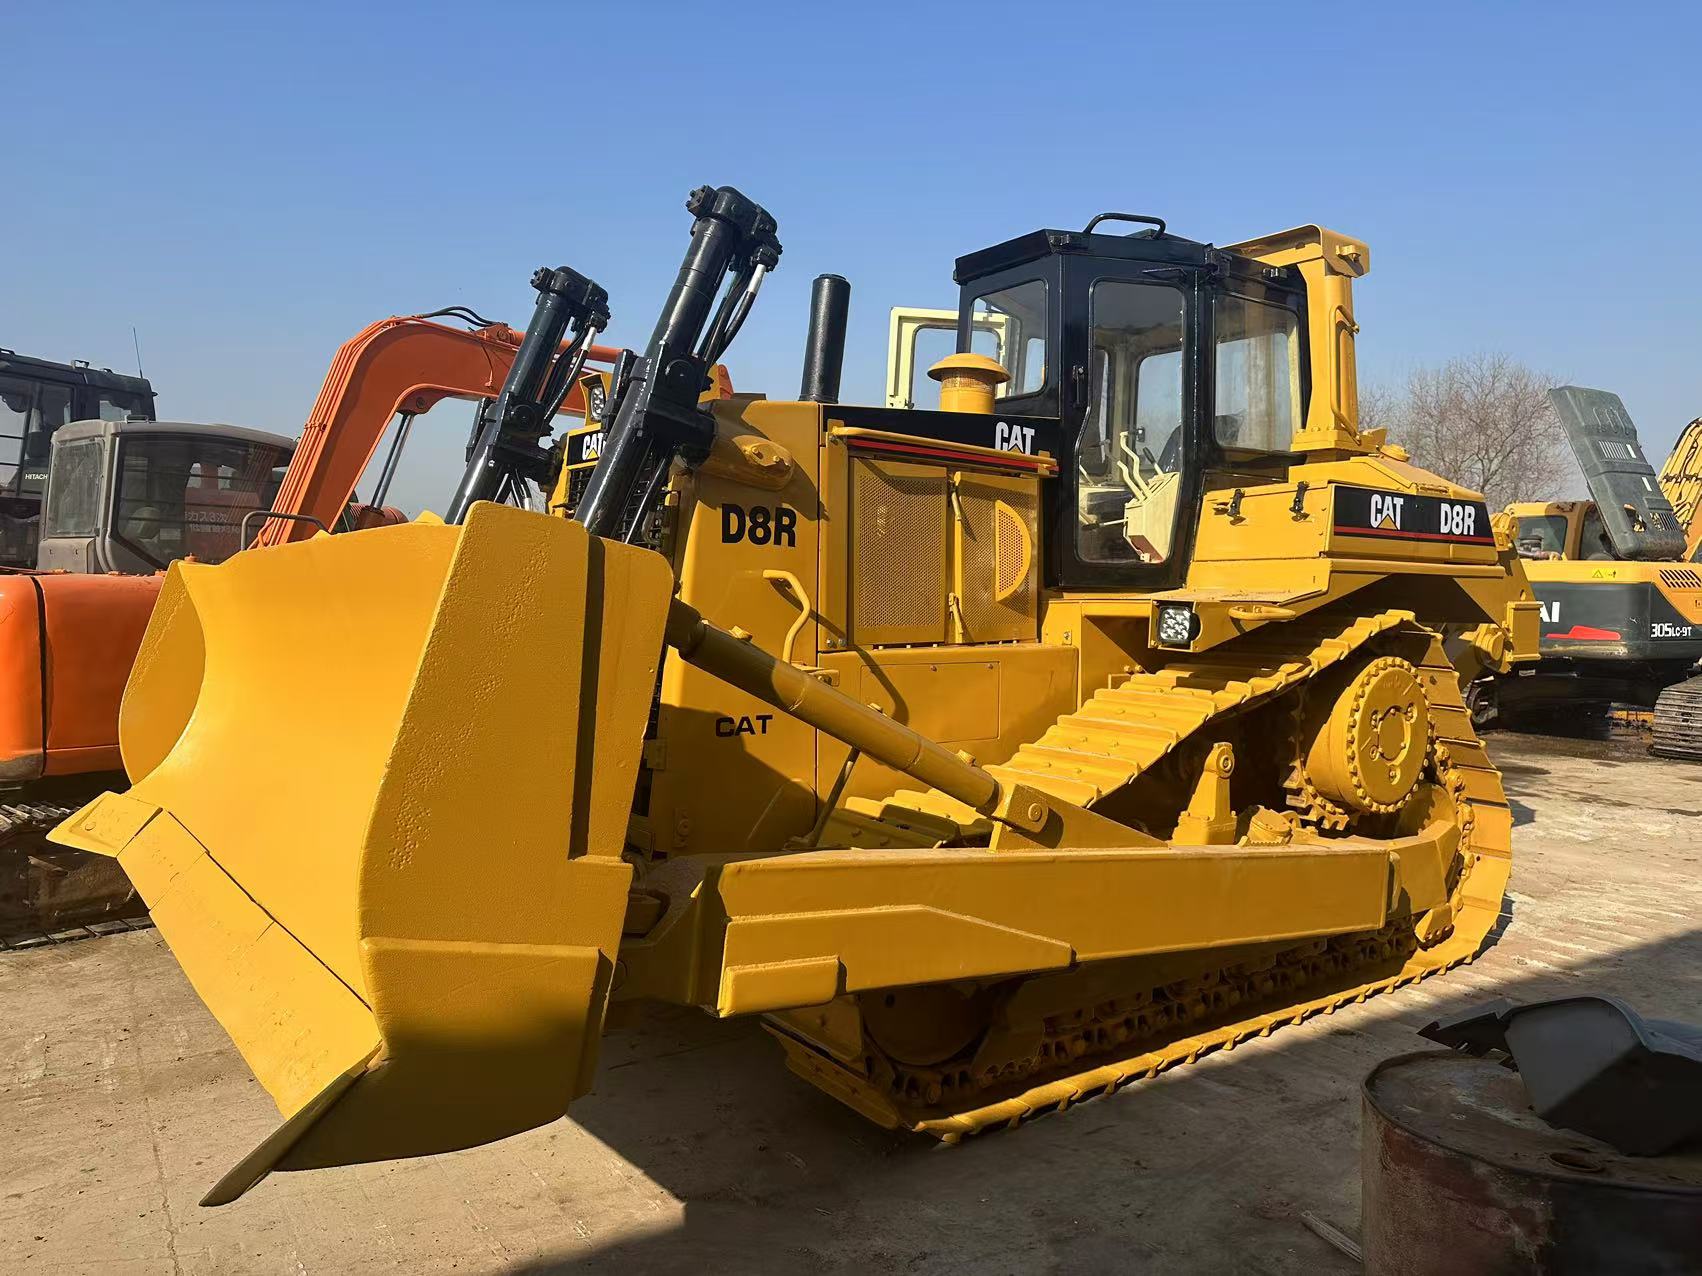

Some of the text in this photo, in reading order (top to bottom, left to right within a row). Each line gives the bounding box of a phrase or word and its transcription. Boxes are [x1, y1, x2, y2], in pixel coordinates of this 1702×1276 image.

[582, 432, 604, 460] CAT
[994, 421, 1035, 456] CAT
[721, 503, 797, 548] D8R
[1370, 493, 1476, 536] CAT D8R
[1650, 622, 1692, 638] 305LC-9T
[715, 714, 773, 738] CAT
